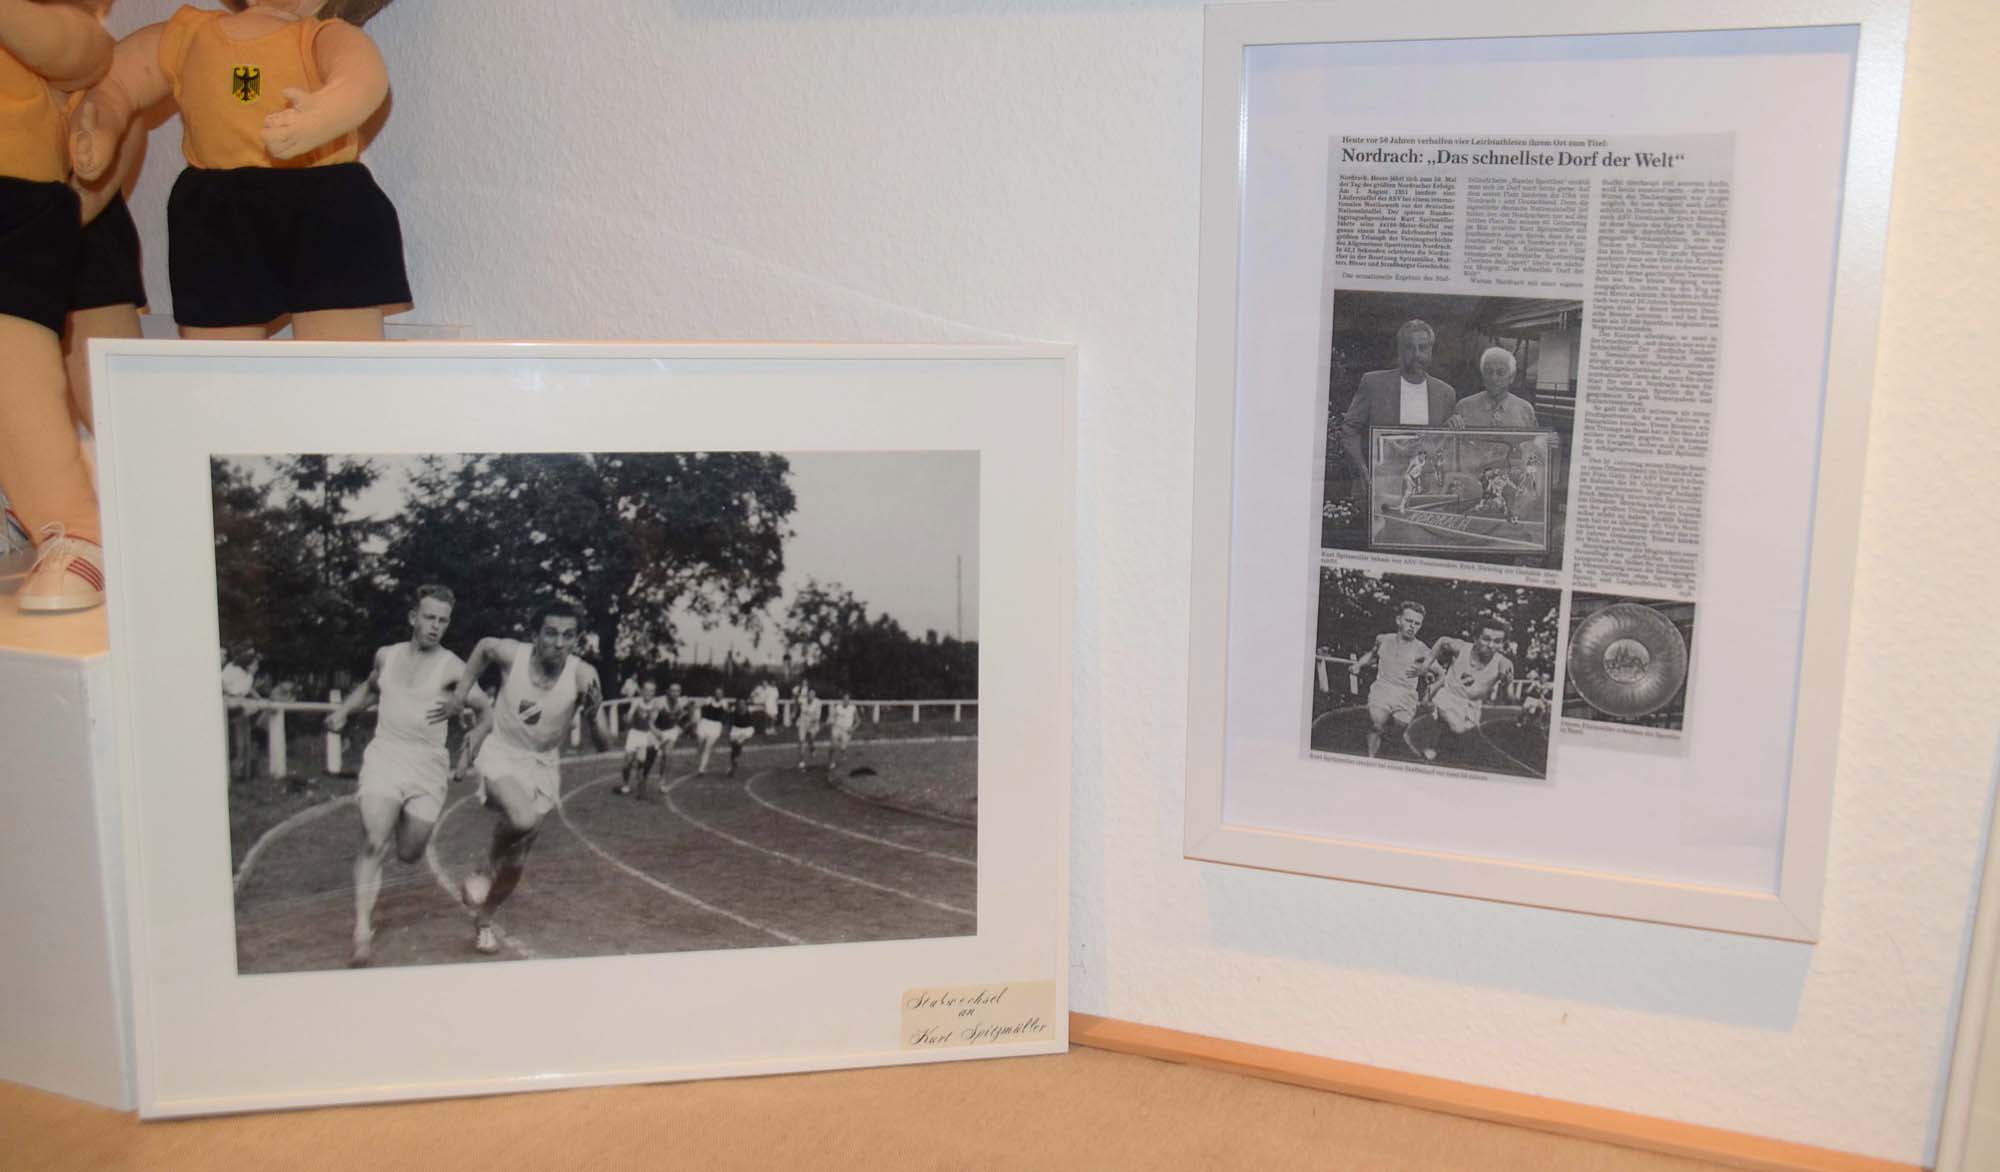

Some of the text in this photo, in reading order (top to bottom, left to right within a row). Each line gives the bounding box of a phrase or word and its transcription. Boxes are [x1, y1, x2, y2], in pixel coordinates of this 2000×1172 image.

[1342, 136, 1363, 144] Heute
[1390, 136, 1416, 144] Jahren
[1455, 137, 1469, 145] vier
[1553, 138, 1567, 146] Ort
[1342, 147, 1423, 163] Nordrach:
[1472, 149, 1554, 165] schnellste
[1557, 150, 1599, 167] Dorf
[1602, 152, 1631, 168] der
[906, 986, 1009, 1009] Stabwechsel
[958, 1008, 975, 1017] an
[909, 1025, 952, 1045] Kurt
